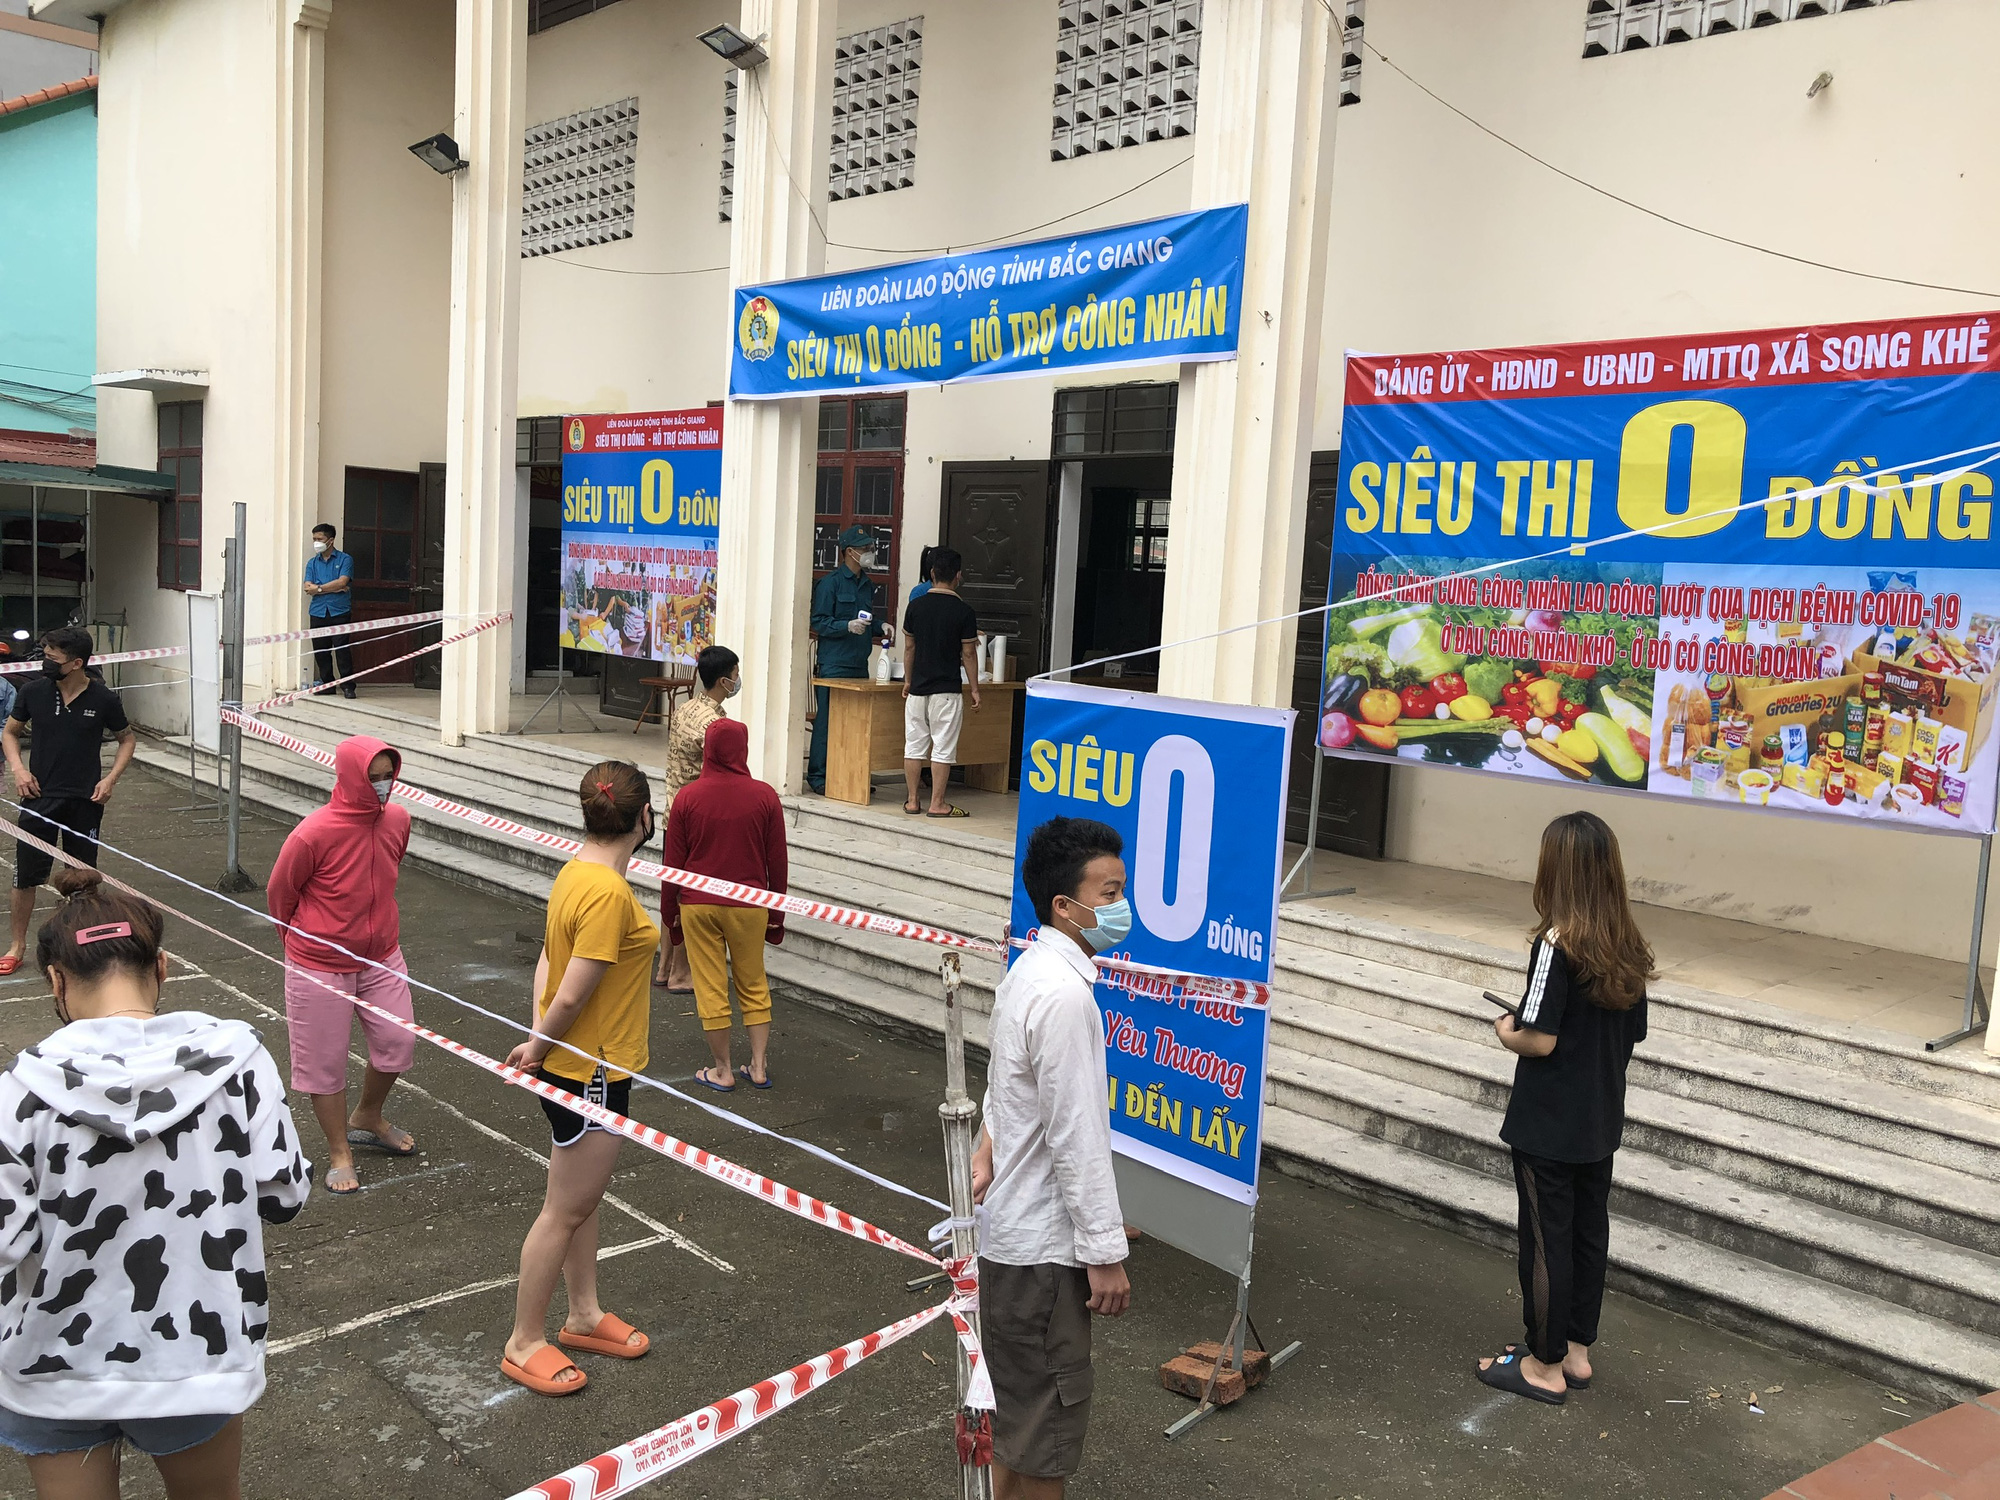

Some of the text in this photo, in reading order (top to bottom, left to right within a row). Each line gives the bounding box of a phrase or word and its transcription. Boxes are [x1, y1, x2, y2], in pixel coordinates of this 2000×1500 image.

[820, 236, 1174, 312] LIÊN ĐOÀN LAO ĐỘNG TỈNH BẮC GIANG
[787, 330, 830, 380] SIÊU
[833, 333, 863, 384] THỊ
[884, 312, 941, 371] ĐỒNG
[970, 299, 1003, 361] HỖ
[1008, 303, 1057, 365] TRỢ
[1062, 293, 1136, 352] CÔNG
[1143, 277, 1227, 343] NHÂN
[1374, 358, 1434, 396] ĐẢNG
[1439, 354, 1470, 394] ỦY
[1491, 358, 1558, 391] HĐND
[1582, 351, 1655, 386] UBND
[1682, 343, 1760, 382] MTTQ
[1767, 333, 1809, 376] XÃ
[1819, 331, 1911, 373] SONG
[1921, 317, 1990, 366] KHÊ
[595, 431, 609, 448] SIÊU
[611, 433, 621, 450] THỊ
[663, 430, 677, 449] TRỢ
[677, 428, 697, 445] CÔNG
[698, 427, 719, 444] NHÂN
[607, 418, 617, 428] LIÊN
[633, 419, 643, 427] LAO
[686, 416, 706, 425] GIANG
[564, 477, 603, 524] SIÊU
[607, 485, 635, 533] THỊ
[678, 488, 718, 526] ĐỒN
[1345, 446, 1477, 536] SIÊU
[1496, 459, 1594, 556] THỊ
[1762, 456, 1994, 541] ĐỒNG
[1356, 563, 1961, 631] ĐỒNG HÀNH CÙNG CÔNG NHÂN LAO ĐỘNG VƯỢT QUA DỊCH BỆNH COVID-19
[1454, 624, 1484, 656] ĐÂU
[1487, 622, 1530, 659] CÔNG
[1532, 627, 1579, 664] NHÂN
[1582, 629, 1616, 667] KHÓ
[1630, 627, 1645, 669] Ở
[1647, 631, 1673, 670] ĐÓ
[1675, 631, 1699, 672] CÓ
[1704, 631, 1755, 677] CÔNG
[1760, 639, 1816, 681] ĐOÀN
[1727, 732, 1741, 741] DON
[1766, 699, 1822, 717] Groceries
[1028, 735, 1134, 807] SIÊU
[1207, 914, 1263, 962] ĐỒNG
[1105, 1010, 1147, 1058] Yêu
[1153, 1027, 1246, 1100] Thương
[1125, 1082, 1183, 1137] ĐẾN
[1190, 1105, 1248, 1160] LẤY
[632, 1443, 649, 1459] AREA
[651, 1429, 678, 1451] ALLOWED
[680, 1423, 692, 1437] NOT
[681, 1436, 696, 1450] KHU
